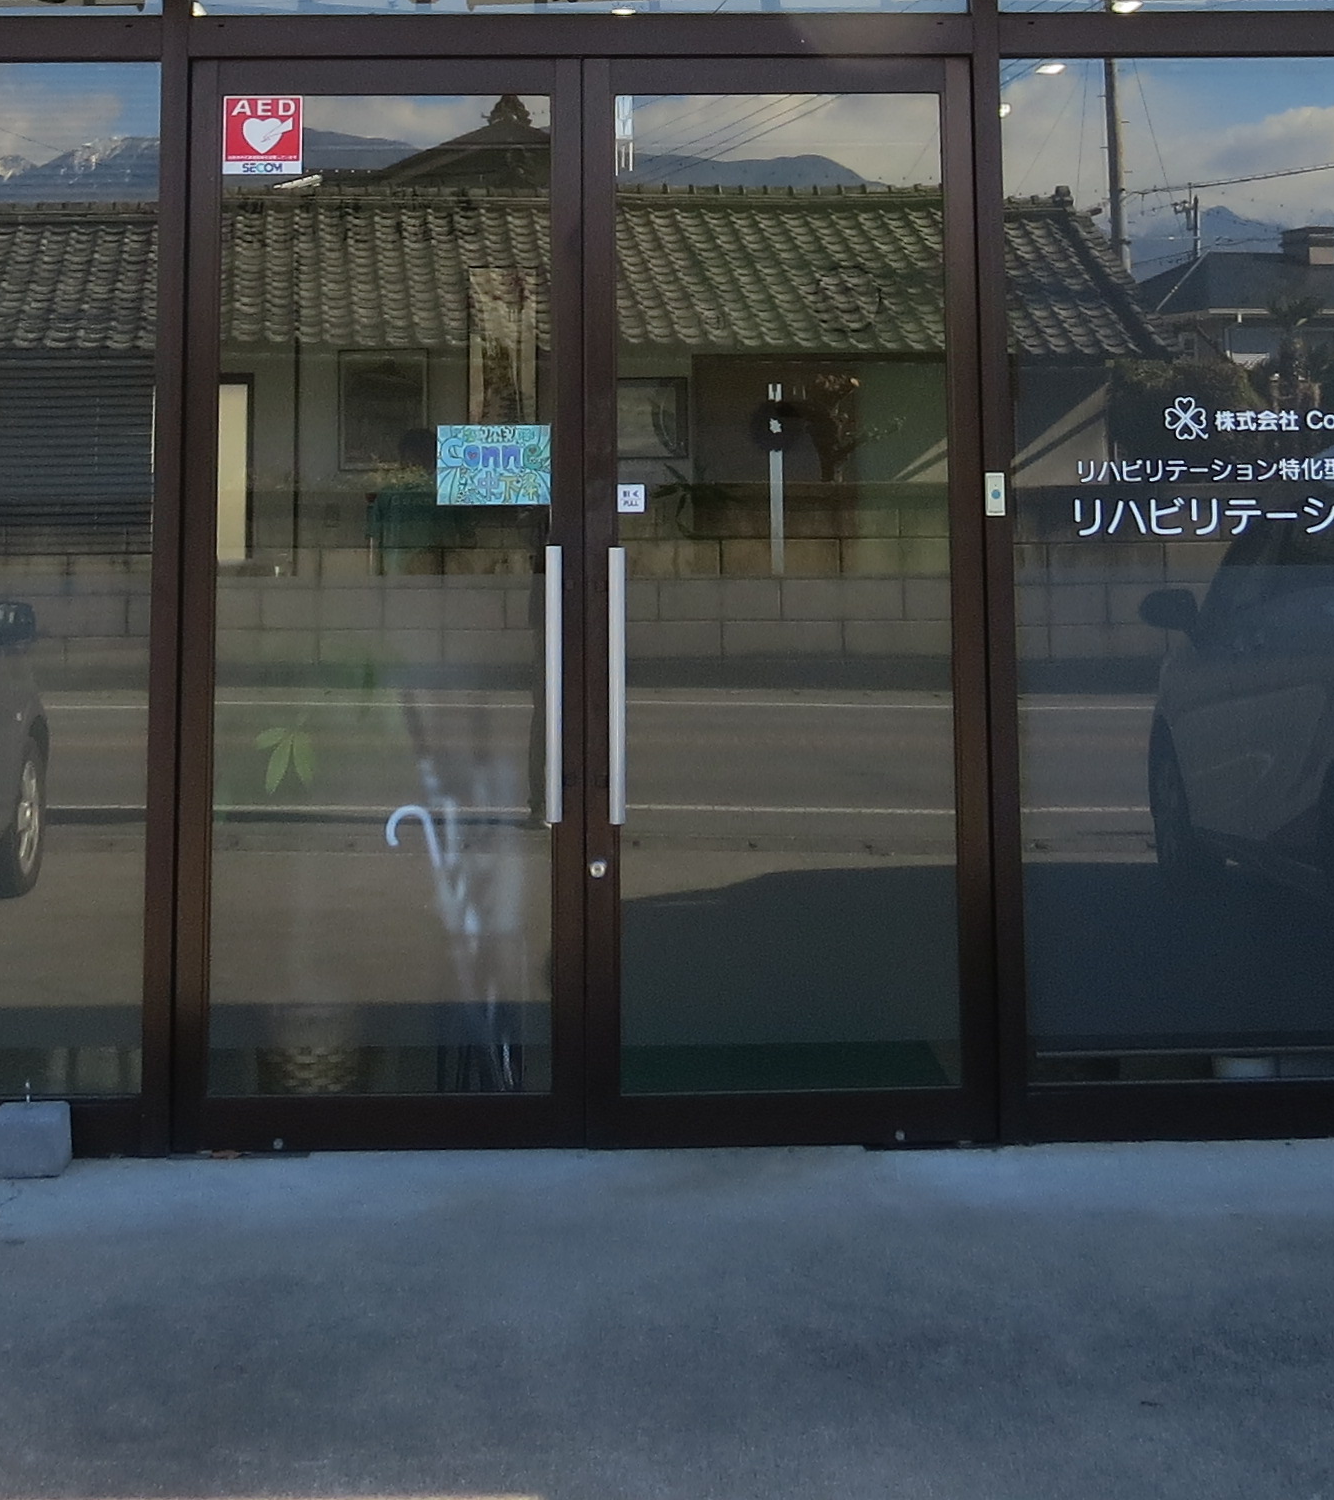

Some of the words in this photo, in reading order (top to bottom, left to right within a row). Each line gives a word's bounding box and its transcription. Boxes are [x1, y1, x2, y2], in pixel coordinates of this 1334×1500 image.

[231, 99, 296, 116] AED
[242, 163, 283, 173] SECOM
[1215, 409, 1299, 432] 株式会社
[441, 437, 543, 470] Conne
